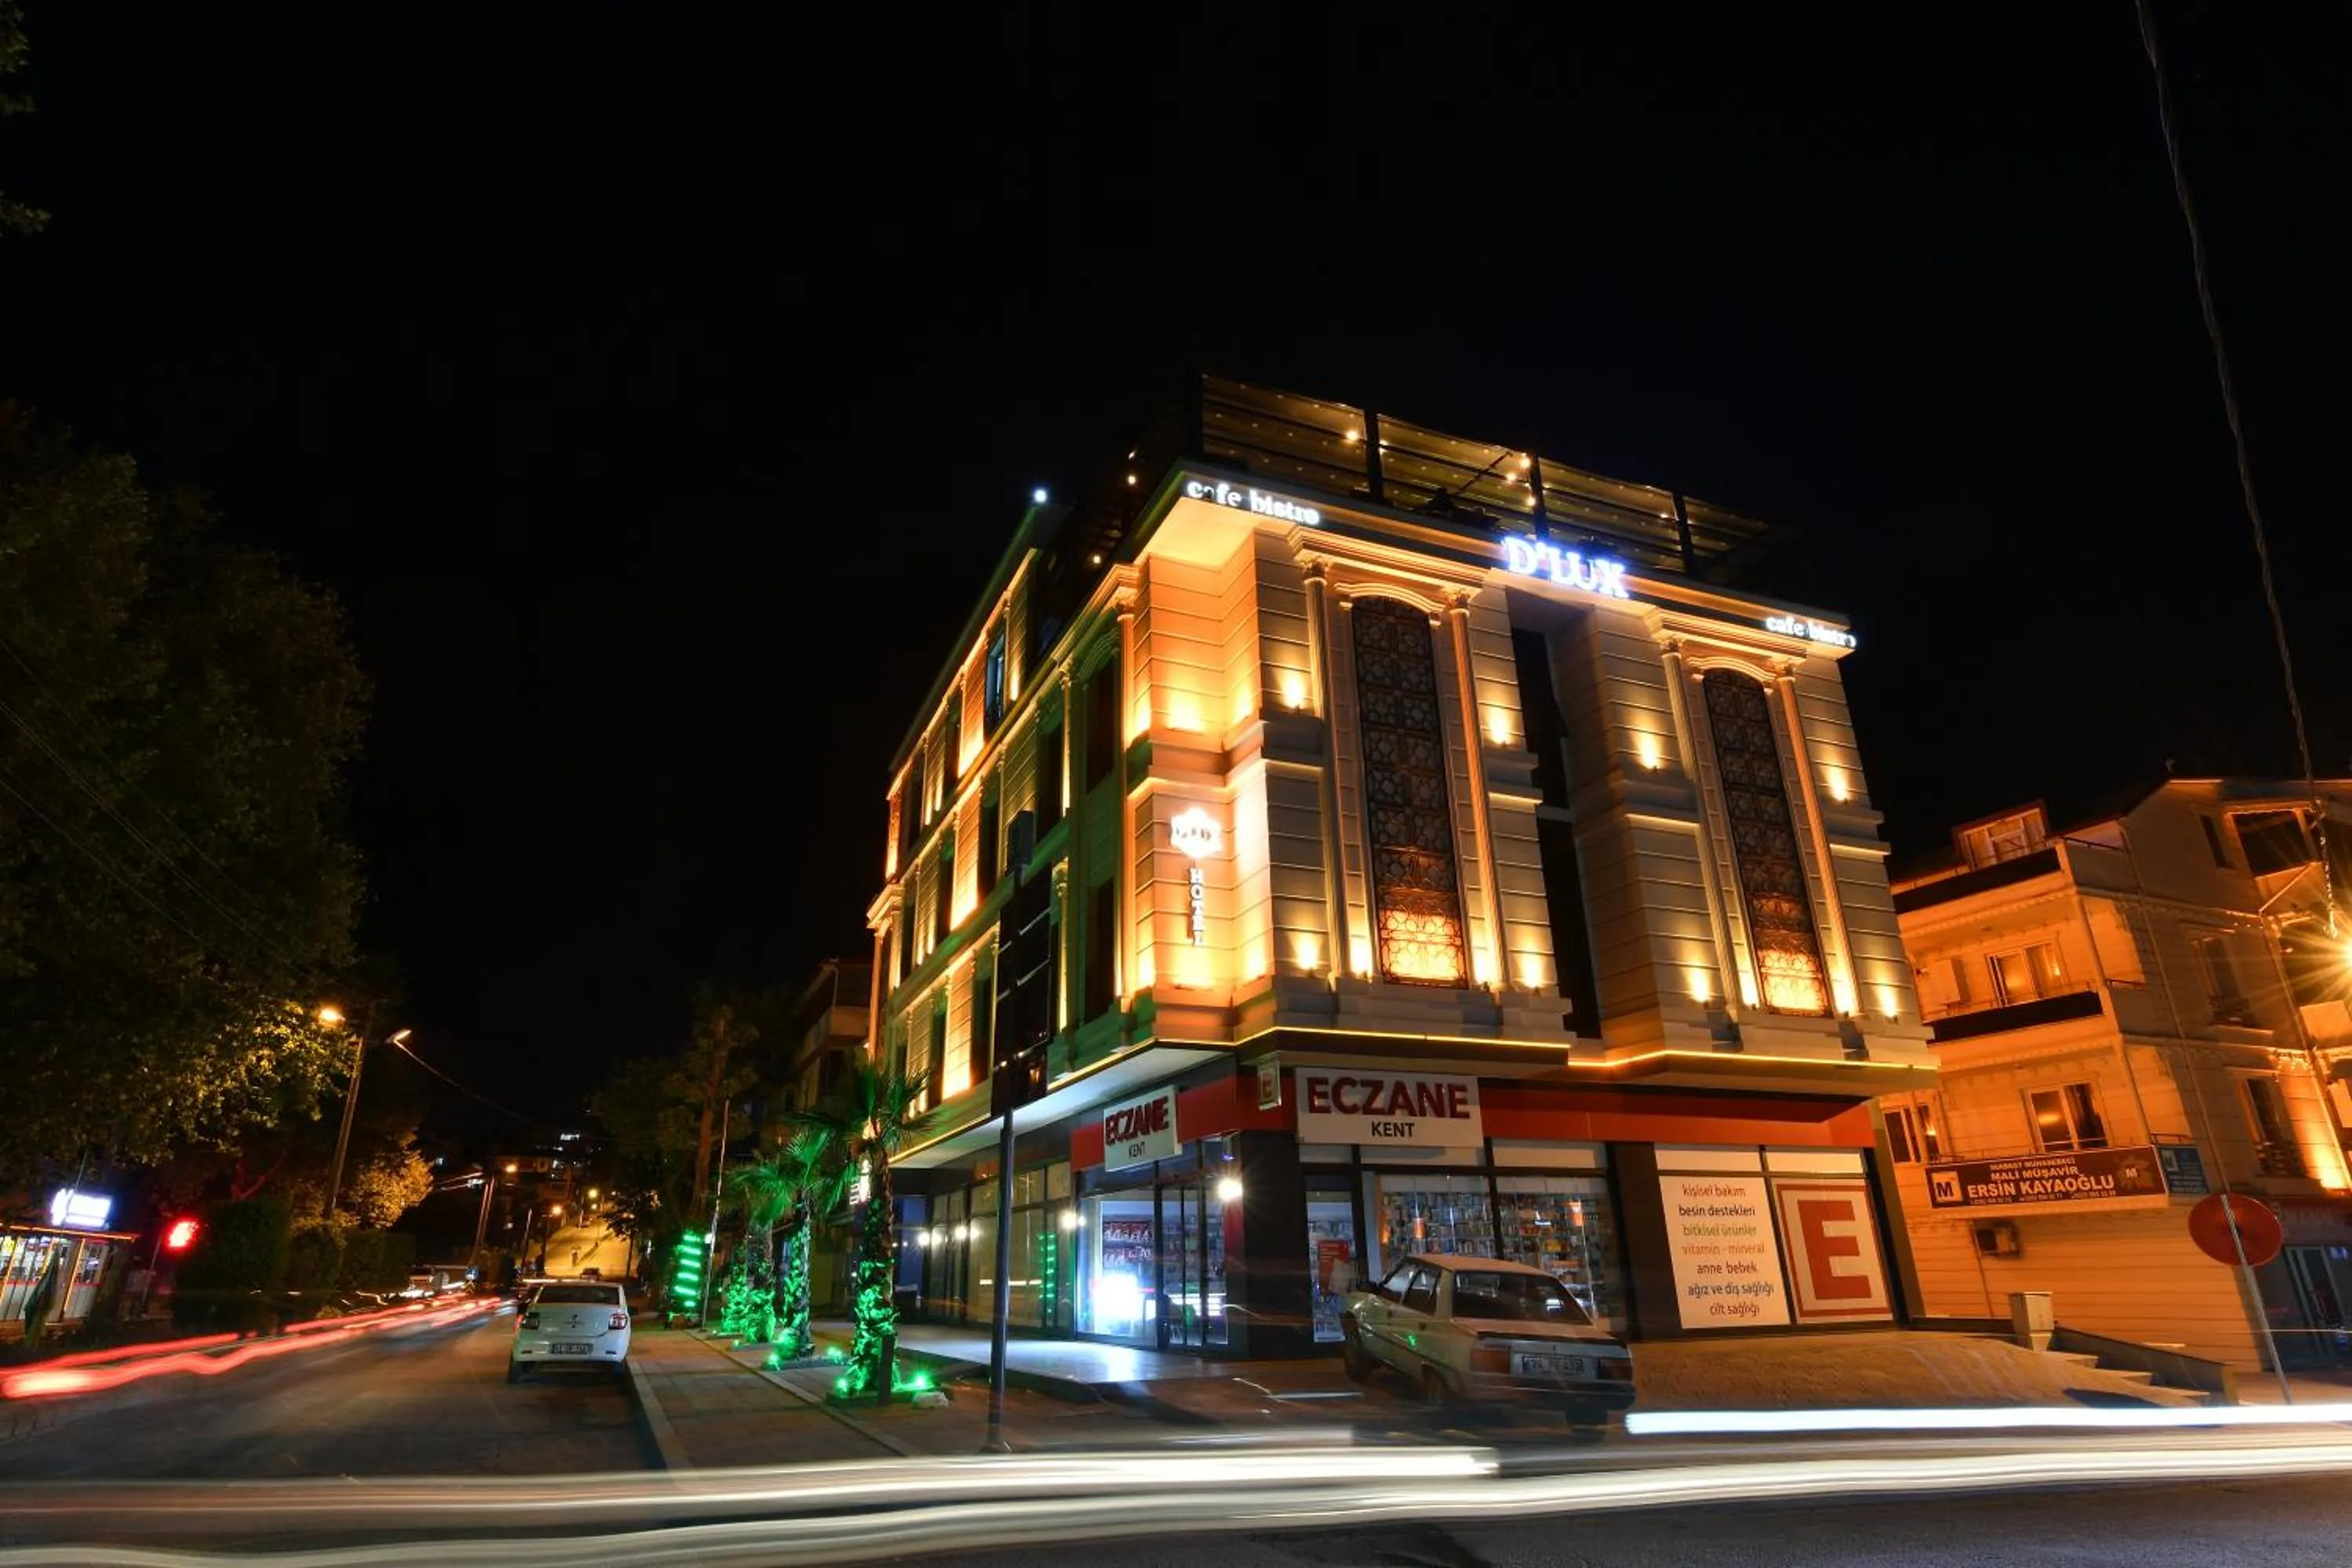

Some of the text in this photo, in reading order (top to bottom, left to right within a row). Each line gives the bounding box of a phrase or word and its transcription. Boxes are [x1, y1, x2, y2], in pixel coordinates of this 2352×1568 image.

[1249, 488, 1320, 525] bistro
[1501, 536, 1629, 598] D'LUX
[1190, 868, 1204, 946] HOTEL
[1307, 1076, 1471, 1119] ECZANE
[1105, 1096, 1169, 1145] ECZANE
[1372, 1121, 1415, 1138] KENT
[1129, 1141, 1145, 1158] KENT
[1682, 1183, 1746, 1198] kişisel bakım
[1936, 1181, 1955, 1197] M
[1967, 1181, 2016, 1198] ERSİN
[2020, 1174, 2115, 1194] KAYAOĞLU
[1679, 1204, 1755, 1217] besin destekleri
[1682, 1224, 1720, 1236] bitkisel
[1682, 1243, 1720, 1255] vitamin
[1797, 1200, 1872, 1300] E
[1697, 1261, 1758, 1274] anne bebek
[1688, 1284, 1709, 1298] ağız
[1710, 1286, 1722, 1296] ve
[1709, 1302, 1726, 1316] cilt
